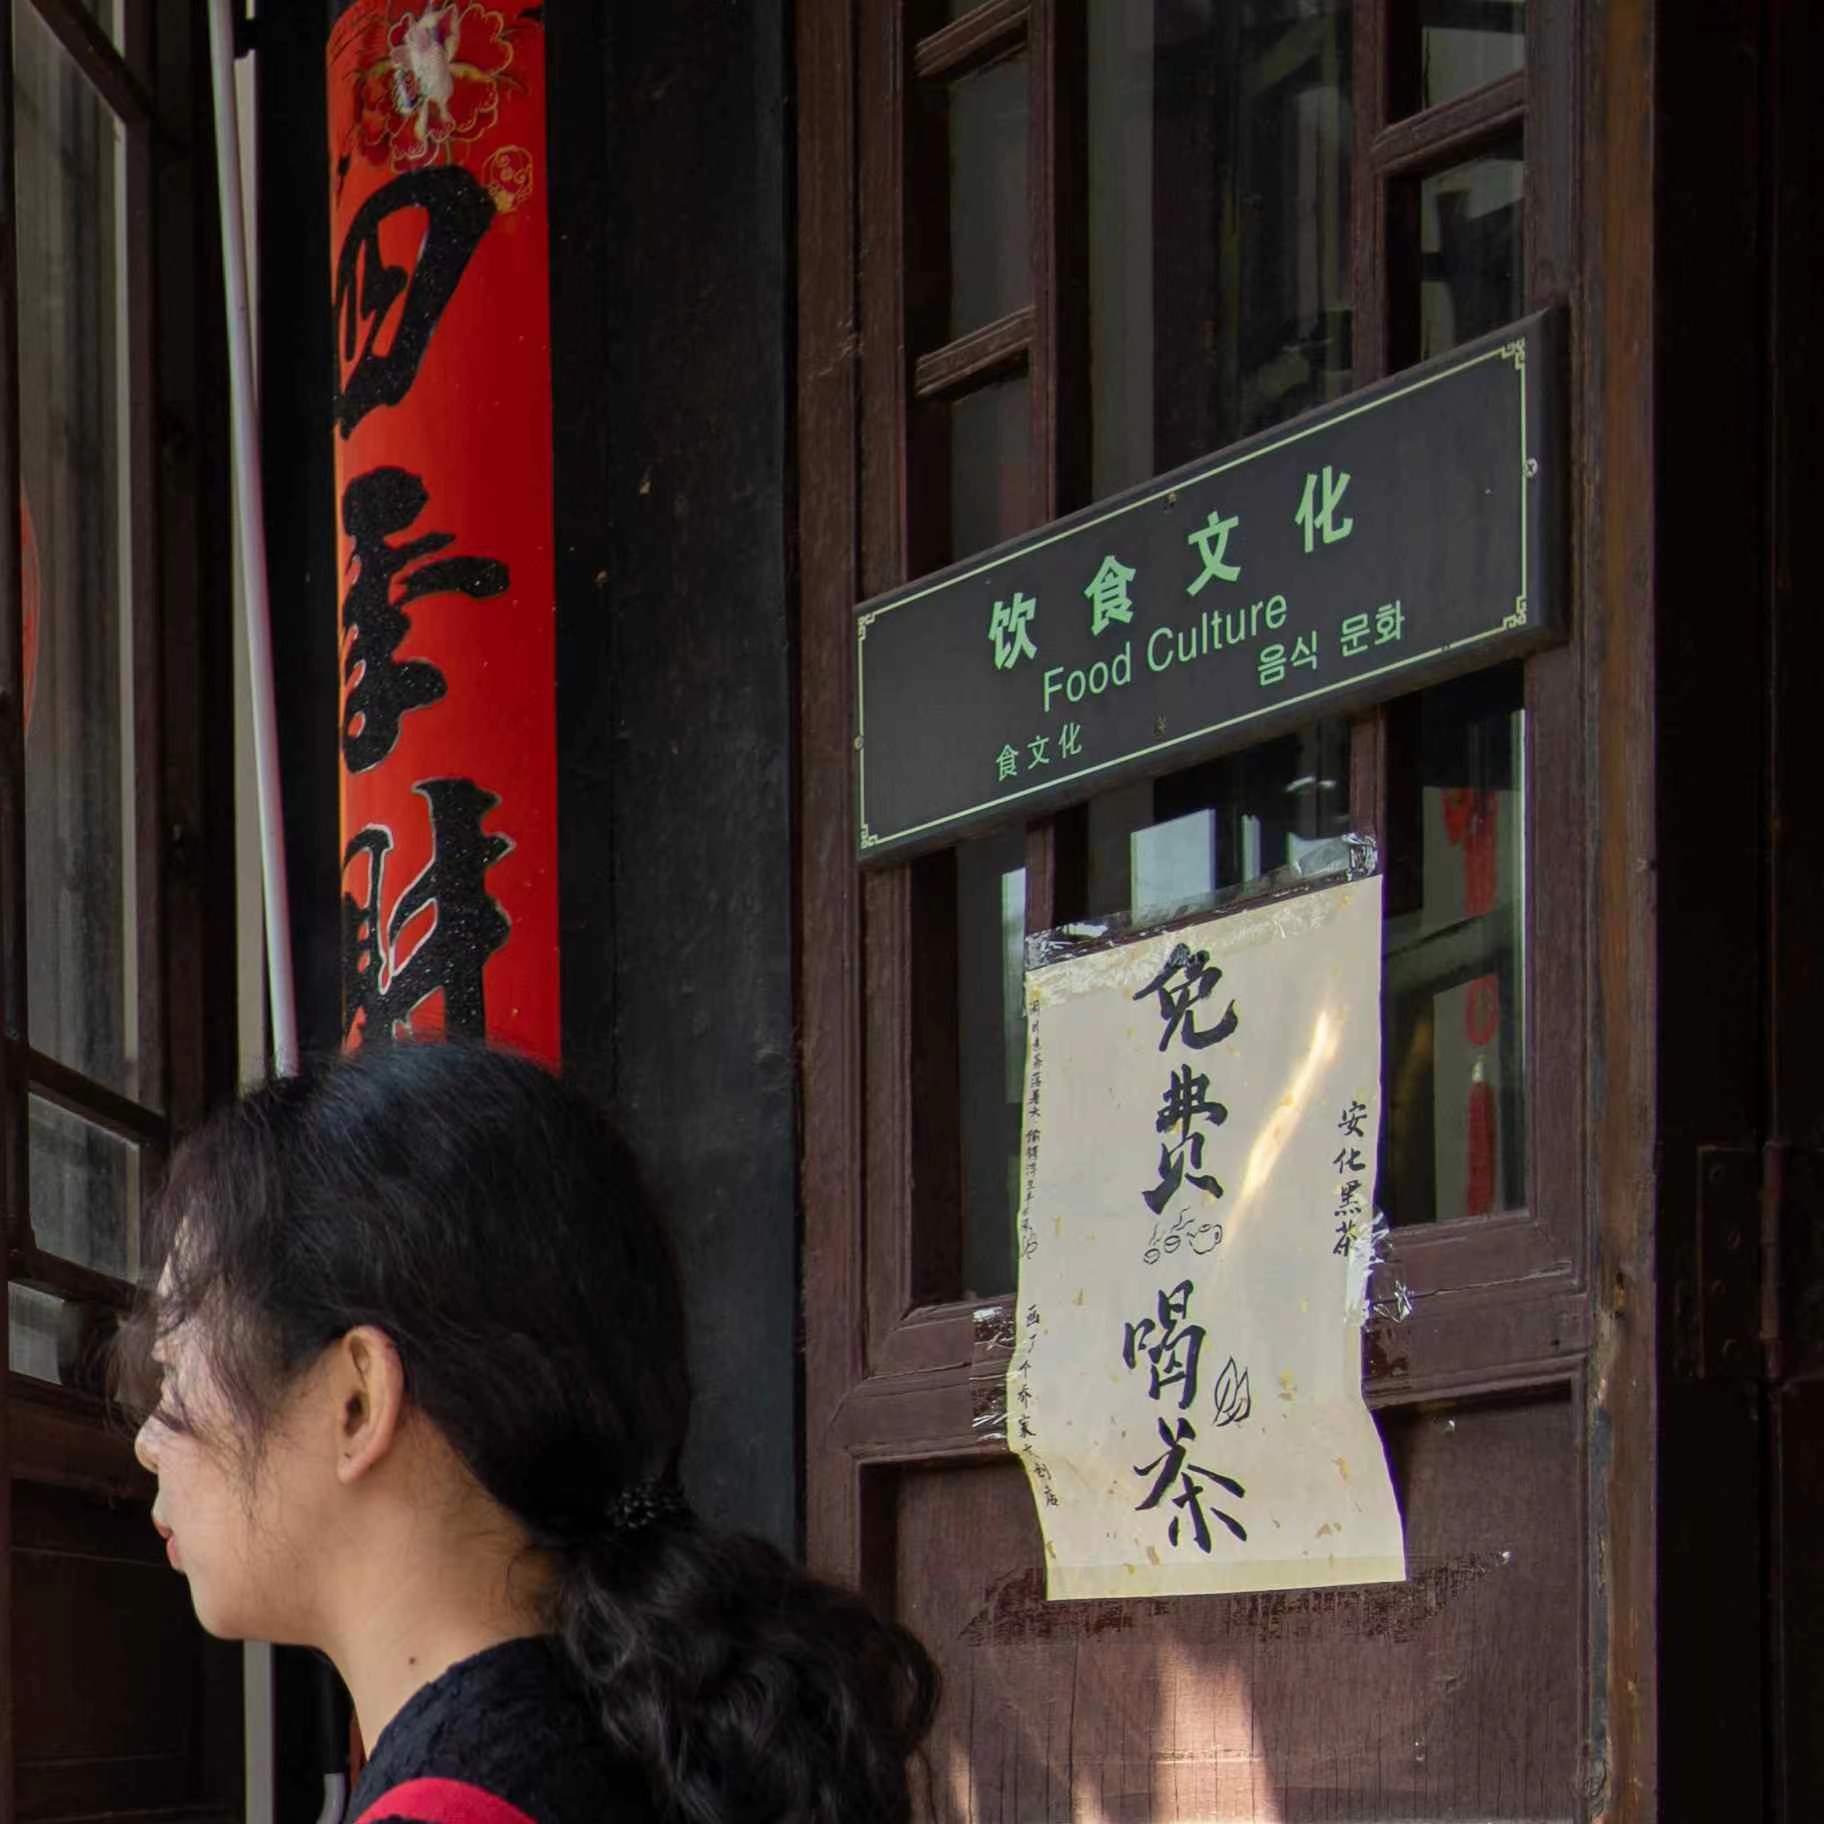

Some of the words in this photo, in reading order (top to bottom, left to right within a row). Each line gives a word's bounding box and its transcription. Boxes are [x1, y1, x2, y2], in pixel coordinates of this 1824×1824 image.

[988, 465, 1354, 671] 饮食文化
[1042, 640, 1133, 712] Food
[1147, 591, 1290, 675] Culture
[1257, 631, 1320, 687] 음식
[1339, 599, 1407, 659] 문화
[995, 721, 1084, 781] 食文化
[1122, 941, 1248, 1553] 免费喝茶
[1331, 1099, 1368, 1258] 安化黑茶
